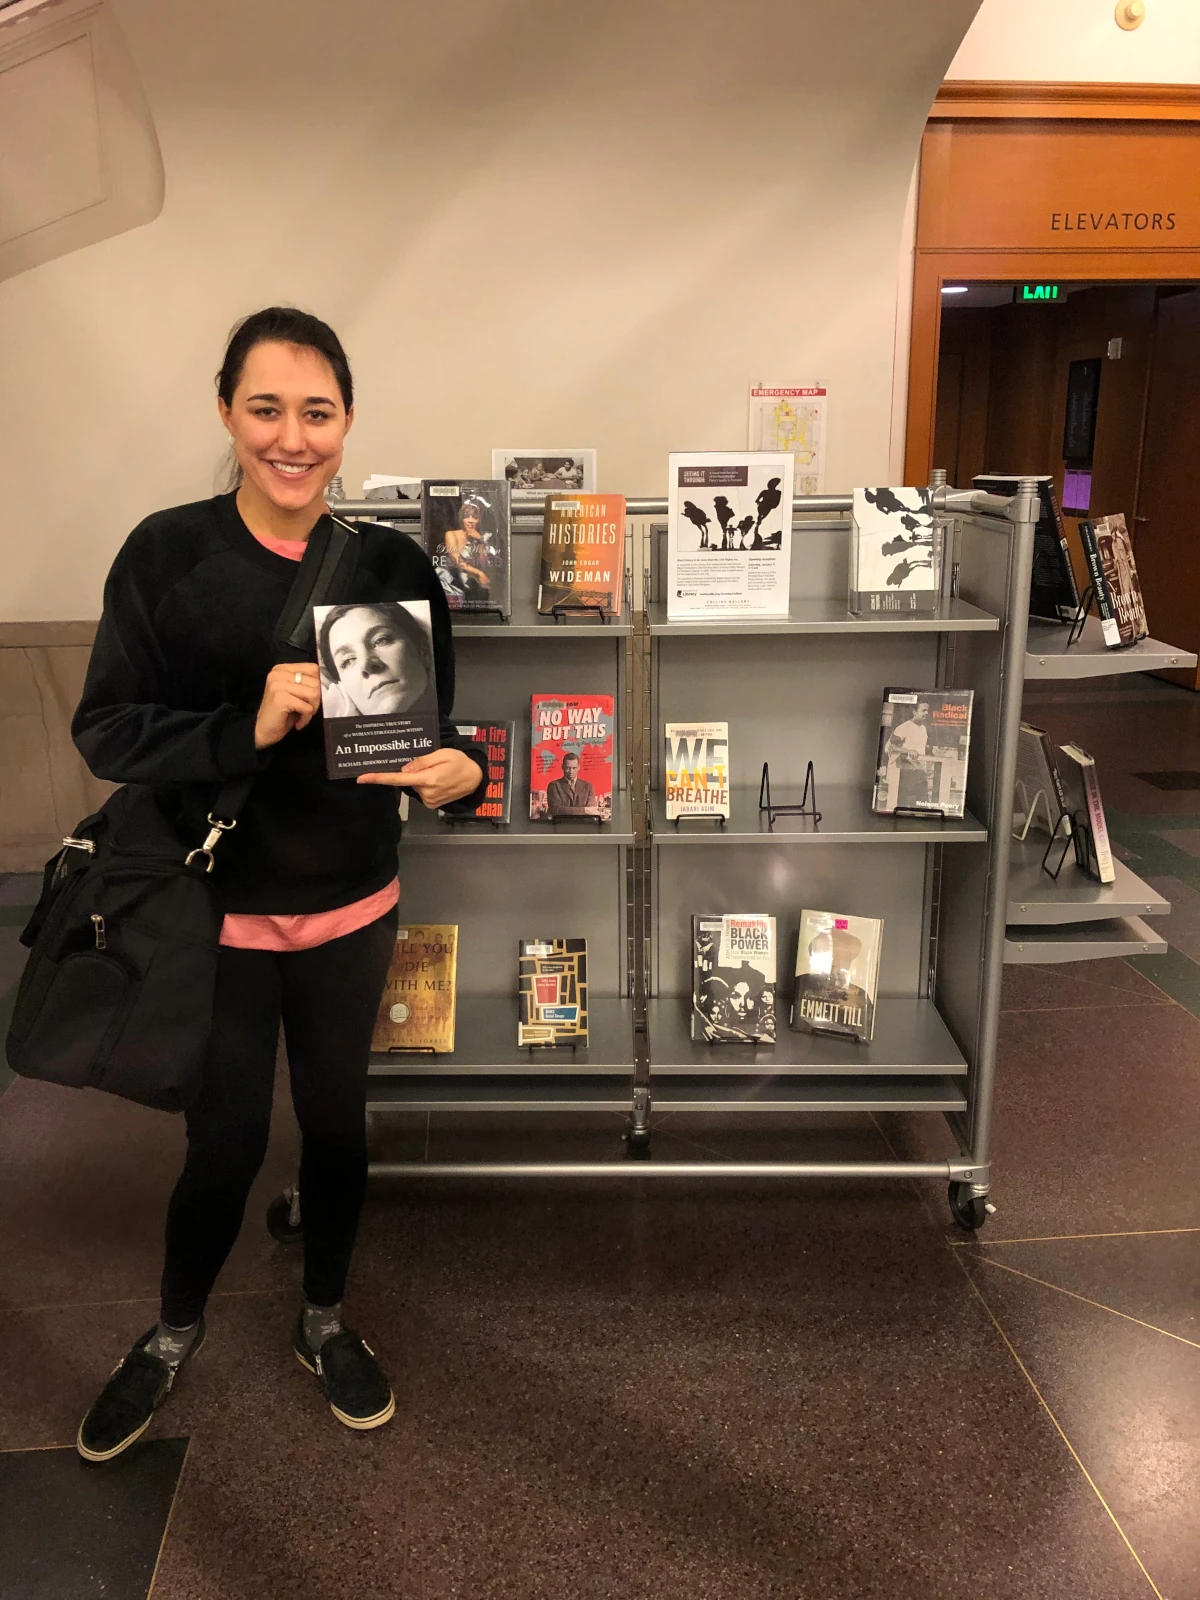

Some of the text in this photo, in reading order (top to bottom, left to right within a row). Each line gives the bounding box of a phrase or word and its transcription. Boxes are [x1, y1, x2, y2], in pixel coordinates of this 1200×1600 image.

[1051, 213, 1176, 230] ELEVATORS
[560, 504, 606, 518] AMERICAN
[550, 523, 616, 544] HISTORIES
[550, 571, 611, 582] WIDEMAN
[1090, 554, 1105, 601] Brown Beauty
[1110, 590, 1138, 609] Brown
[932, 711, 967, 719] Radical
[942, 704, 967, 712] Black
[540, 707, 602, 726] NO WAY
[489, 726, 506, 742] Fire
[542, 724, 606, 741] BUT THIS
[335, 738, 432, 755] An Impossible Life
[488, 744, 505, 761] This
[666, 737, 728, 783] WE
[488, 764, 504, 780] ime
[666, 765, 726, 793] CAN'T
[486, 782, 504, 798] dall
[666, 786, 728, 805] BREATHE
[1095, 813, 1104, 834] MODEL
[730, 920, 768, 928] Remaking
[730, 928, 768, 939] BLACK
[396, 943, 453, 954] ILL YOU
[730, 940, 768, 950] POWER
[405, 961, 428, 972] DIE
[424, 980, 452, 990] ME?
[800, 999, 862, 1027] EMMETT TILL
